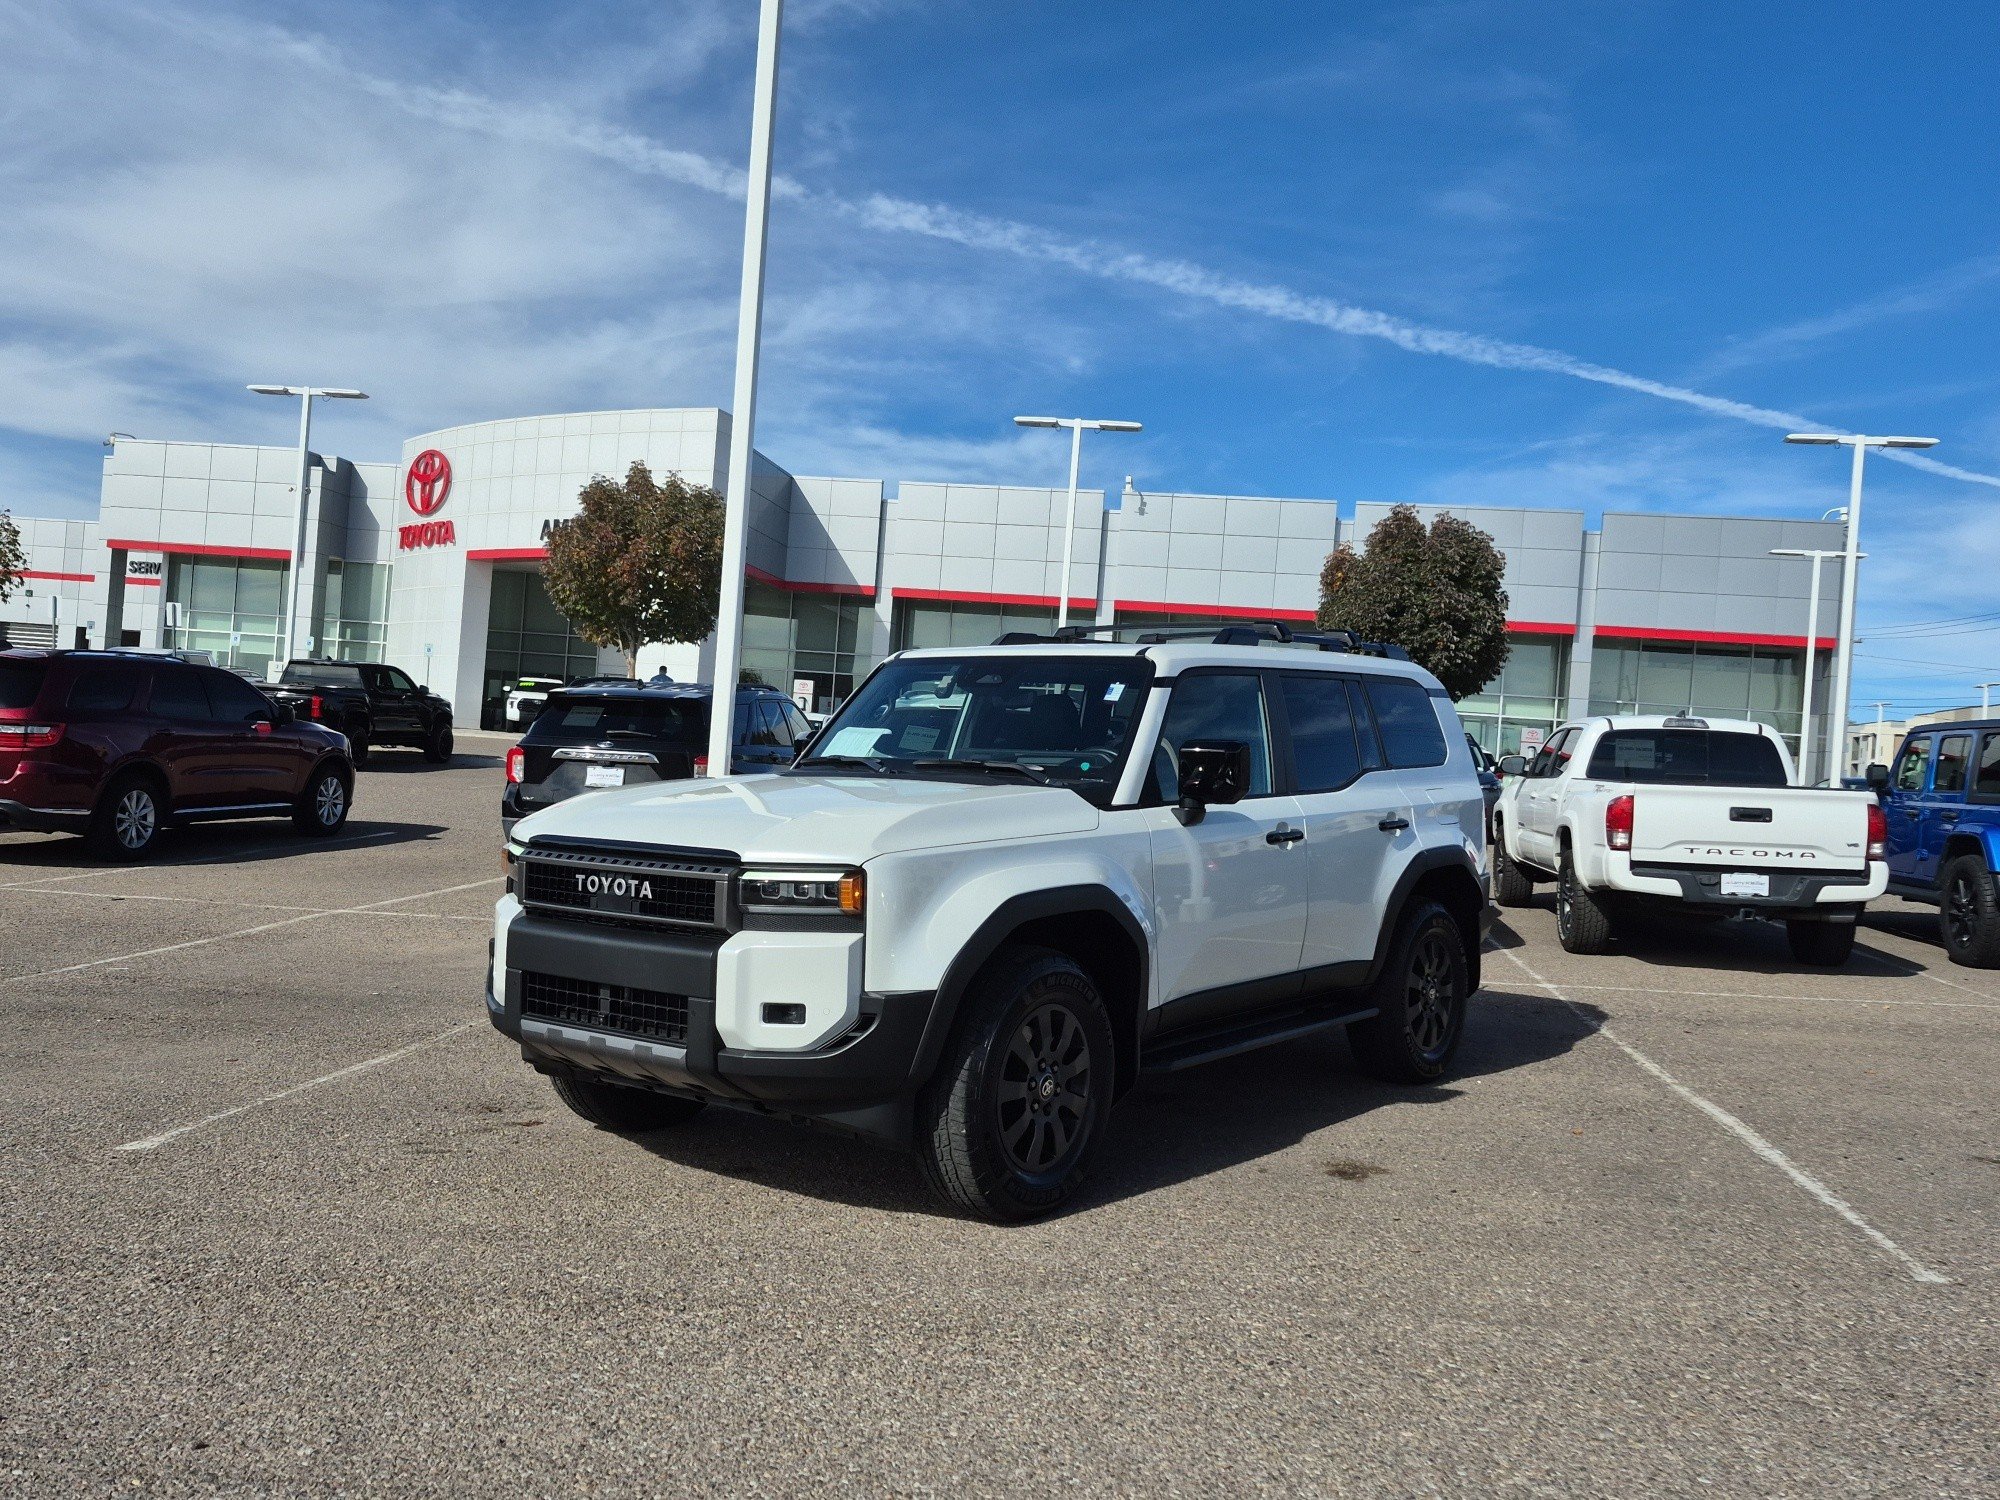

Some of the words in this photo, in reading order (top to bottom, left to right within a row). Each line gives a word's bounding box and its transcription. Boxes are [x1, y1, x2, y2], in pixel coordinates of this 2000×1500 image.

[399, 520, 456, 550] TOYOTA
[128, 560, 162, 575] SERV
[1683, 846, 1816, 859] TACOMA
[575, 874, 653, 899] TOYOTA
